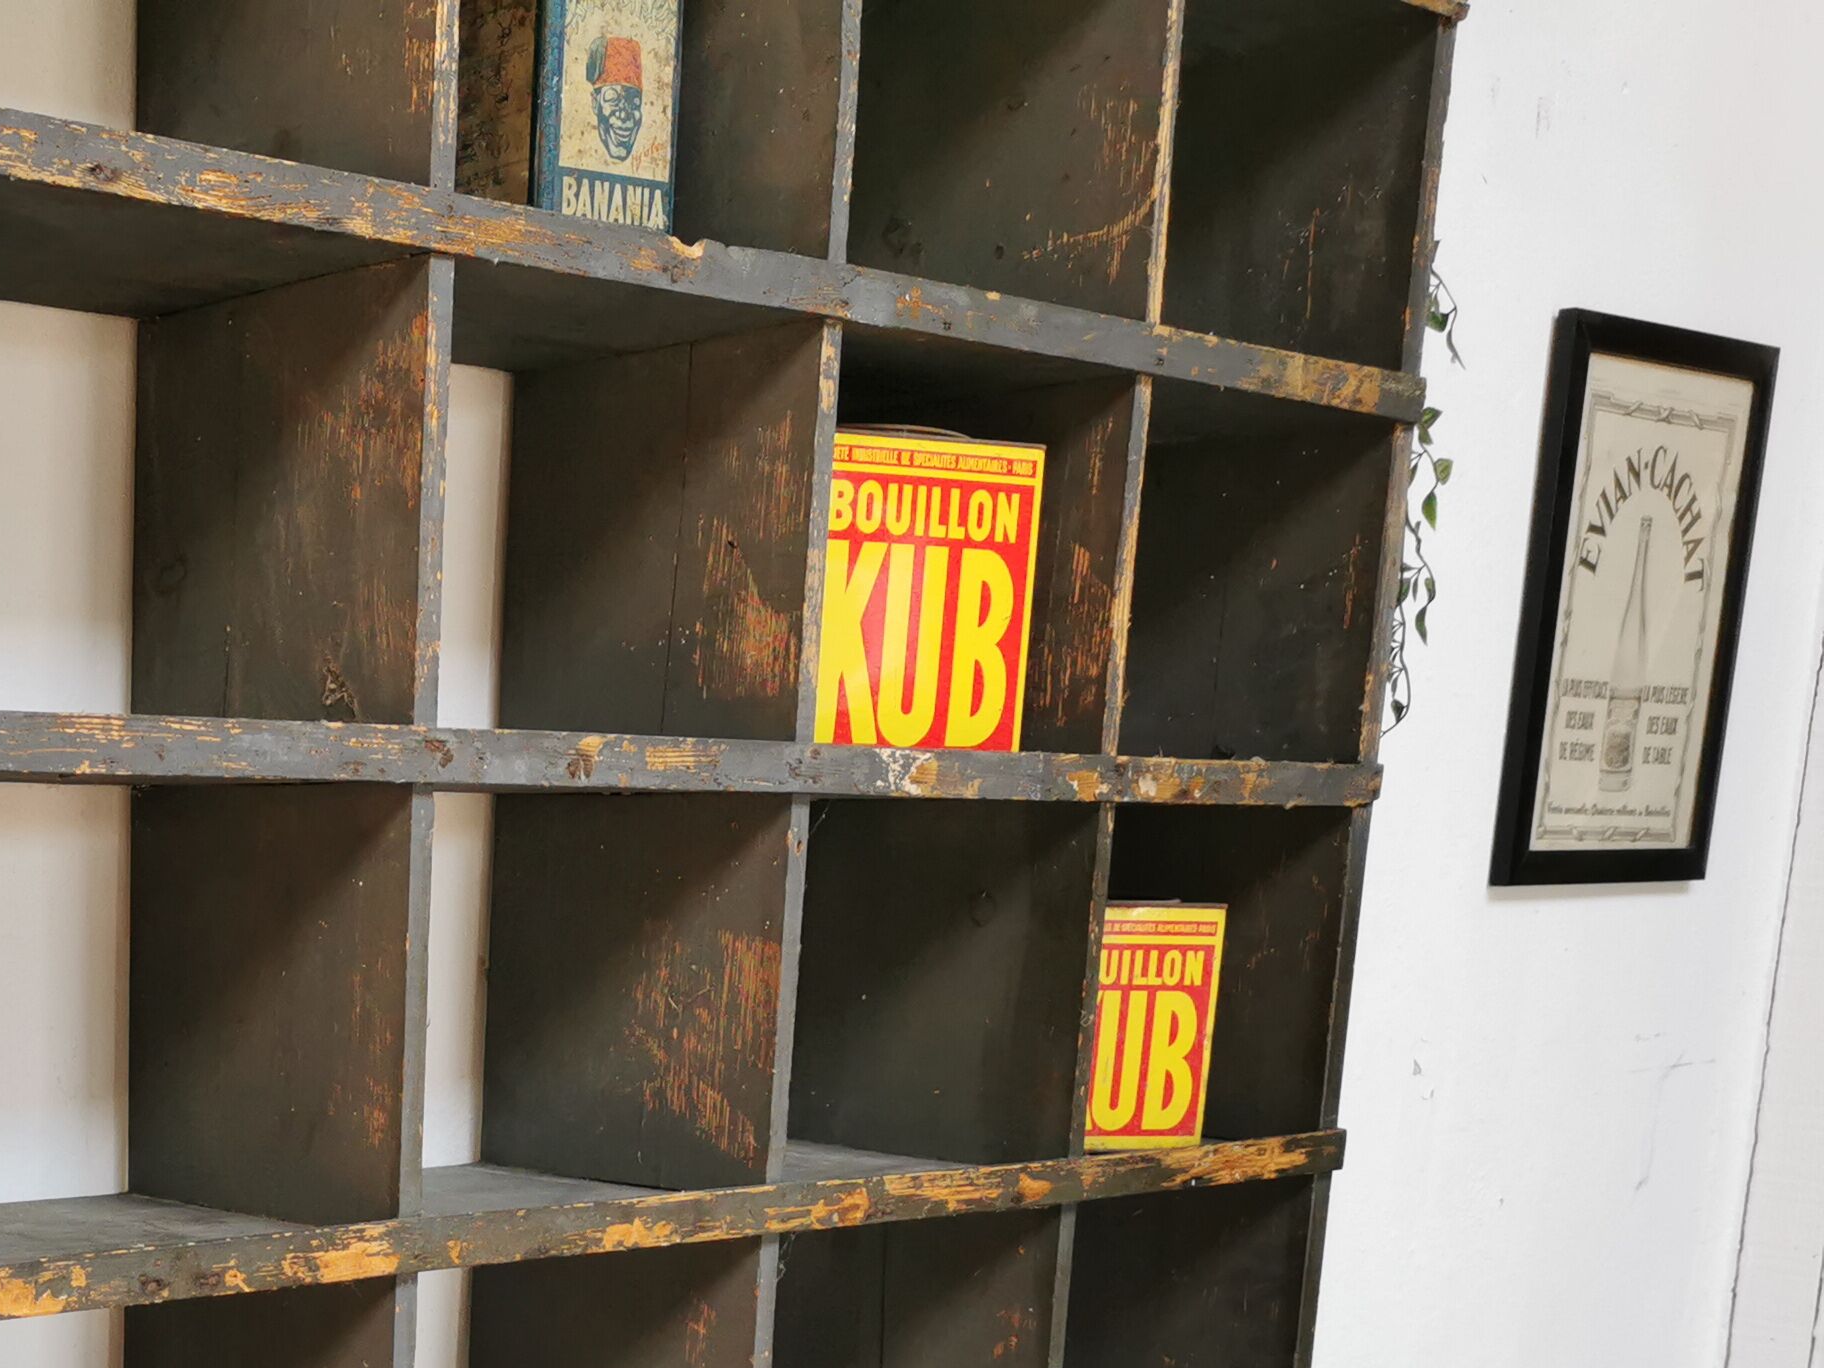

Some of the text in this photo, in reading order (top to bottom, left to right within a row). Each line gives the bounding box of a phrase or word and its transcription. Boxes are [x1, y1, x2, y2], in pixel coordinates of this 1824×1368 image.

[562, 176, 665, 230] BANANIA
[829, 478, 1021, 544] BOUILLON
[814, 538, 1014, 747] KUB
[1098, 949, 1204, 986] UILLON
[1086, 990, 1197, 1131] UB
